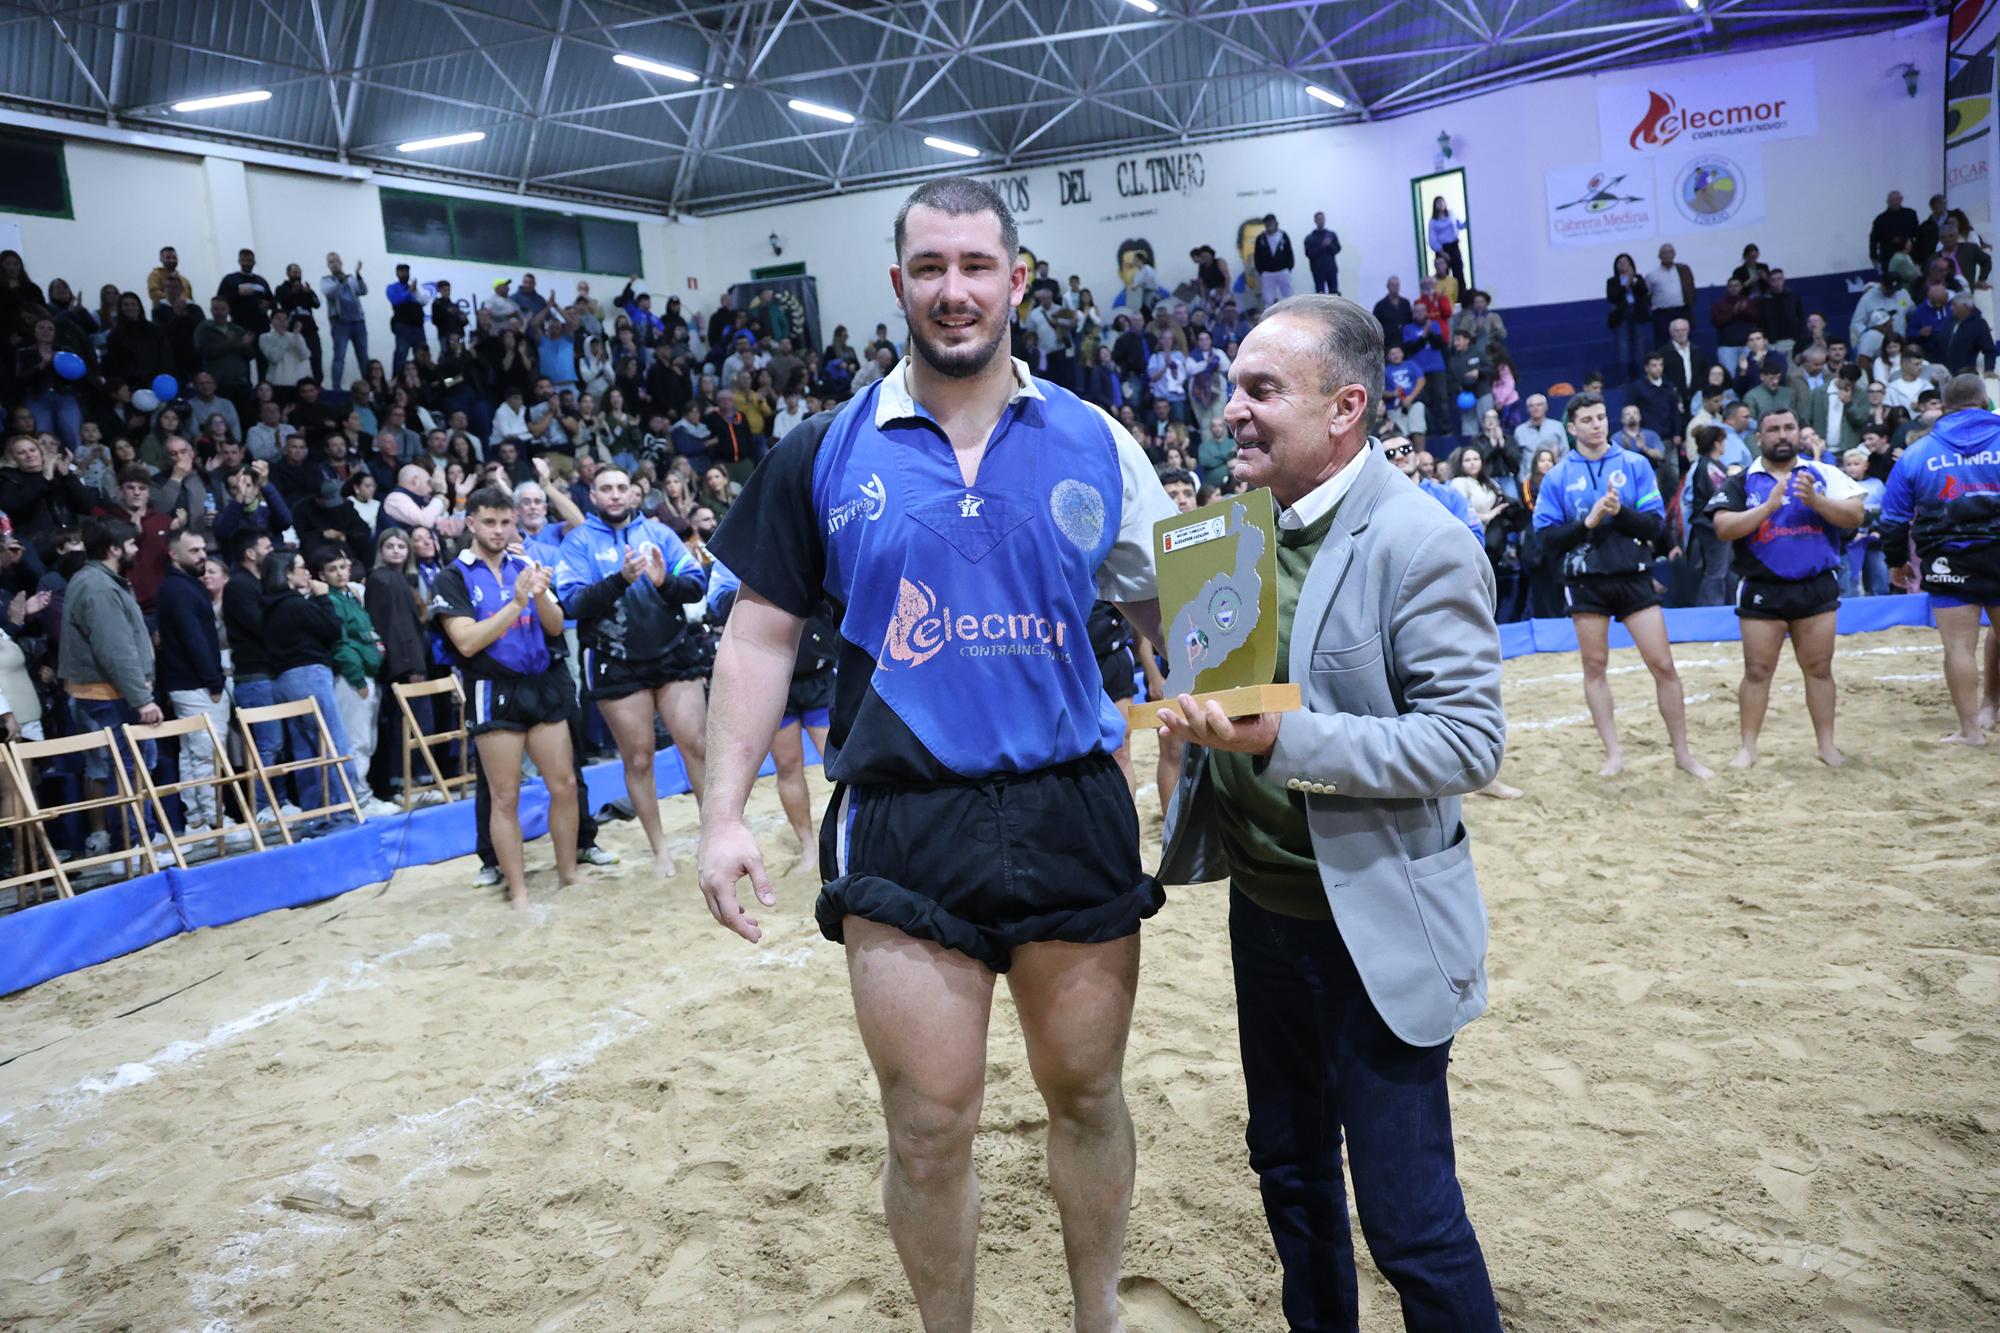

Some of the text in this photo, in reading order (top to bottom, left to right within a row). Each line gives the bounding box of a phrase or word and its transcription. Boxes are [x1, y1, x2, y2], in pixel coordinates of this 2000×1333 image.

[1058, 169, 1092, 206] DEL
[1554, 218, 1602, 232] Cabrera
[1603, 212, 1649, 227] Medina
[913, 607, 1066, 648] elecmor
